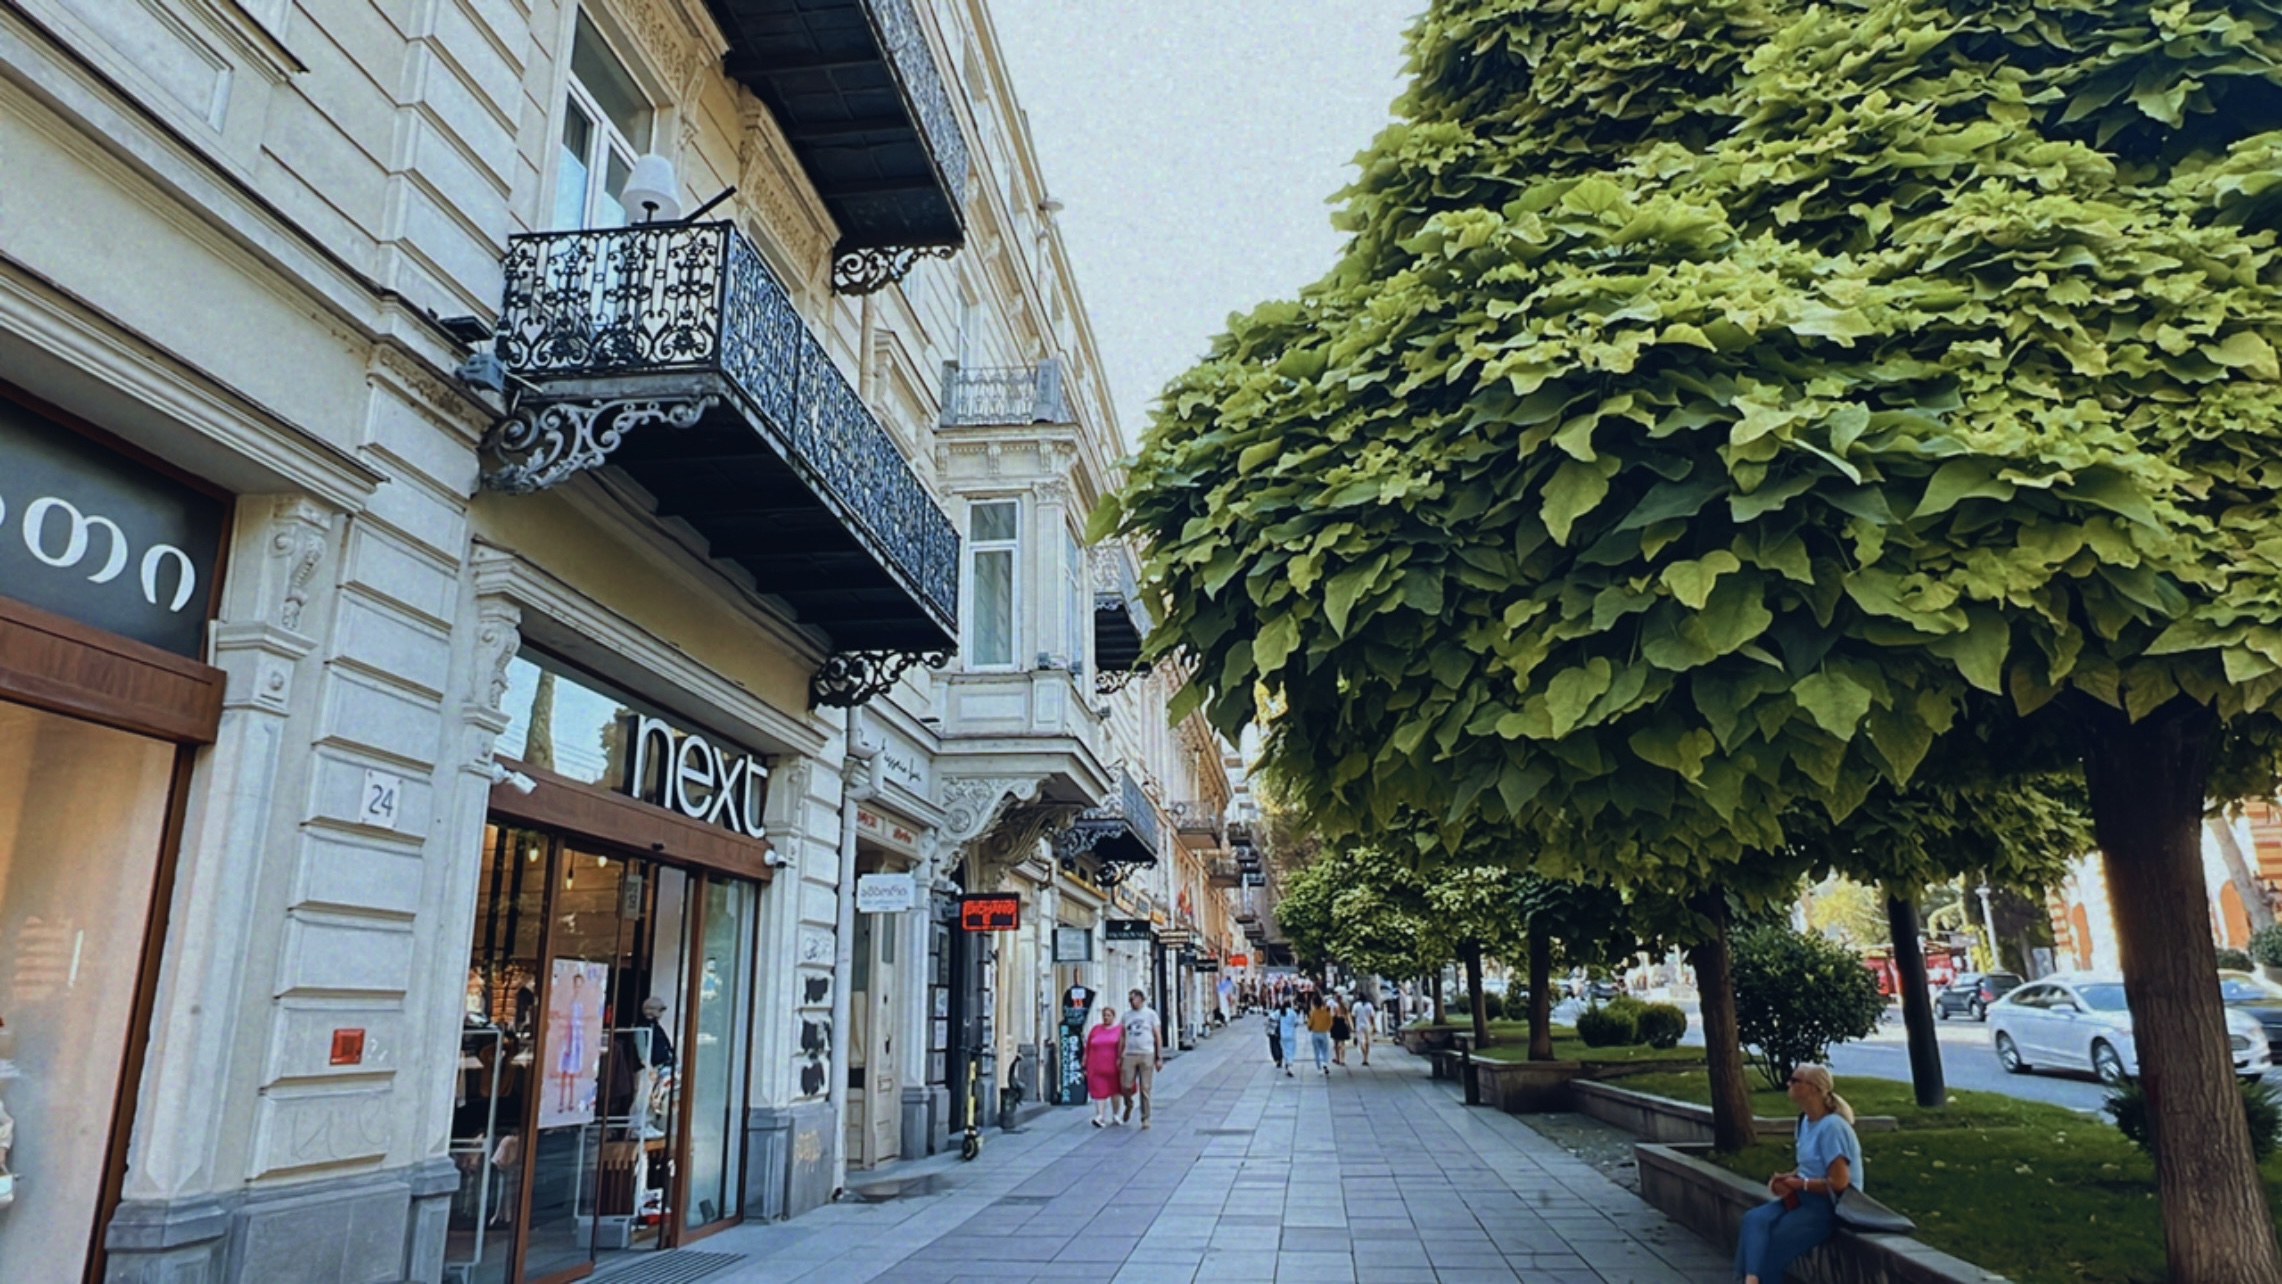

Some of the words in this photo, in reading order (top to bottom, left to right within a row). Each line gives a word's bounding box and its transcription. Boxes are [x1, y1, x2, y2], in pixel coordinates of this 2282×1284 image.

[0, 495, 196, 612] თი
[367, 783, 395, 817] 24
[631, 712, 769, 839] next
